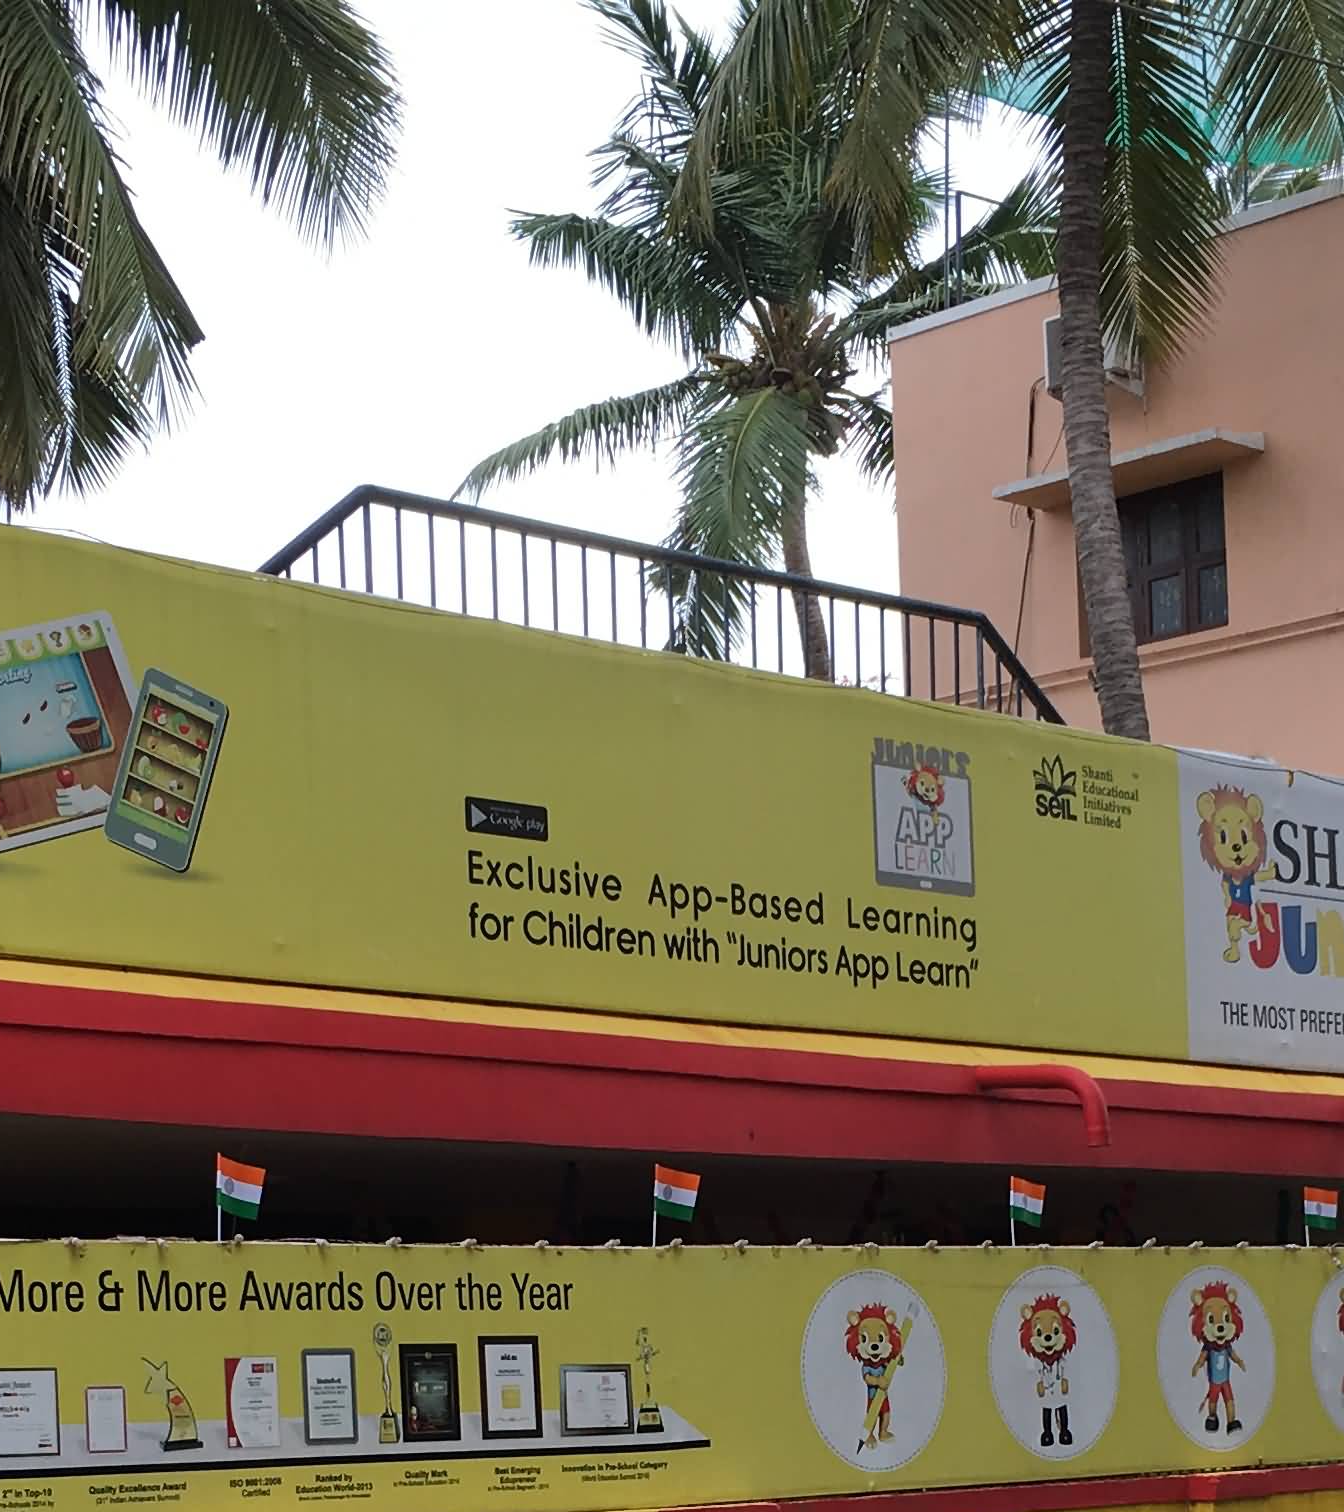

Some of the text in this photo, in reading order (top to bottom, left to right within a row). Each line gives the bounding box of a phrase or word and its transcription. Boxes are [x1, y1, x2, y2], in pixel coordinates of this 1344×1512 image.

[1081, 765, 1113, 782] Shanti
[1082, 782, 1139, 802] Educational
[1083, 796, 1132, 816] Initiatives
[896, 806, 953, 848] APP
[1084, 811, 1122, 829] Limited
[894, 841, 956, 877] LEARN
[466, 850, 978, 952] Exclusive App-Based Learning
[468, 902, 514, 942] for
[522, 909, 656, 959] Children
[663, 924, 720, 964] with
[834, 947, 891, 990] App
[1220, 1001, 1250, 1027] THE
[1253, 1003, 1296, 1032] MOST
[97, 1269, 124, 1313] &
[137, 1269, 228, 1312] More
[239, 1270, 365, 1312] Awards
[375, 1271, 446, 1312] Over
[455, 1272, 503, 1312] the
[509, 1272, 574, 1312] Year
[404, 1470, 448, 1480] Quality Mark
[494, 1466, 541, 1476] Best Emerging
[561, 1463, 596, 1473] Innovation
[605, 1461, 638, 1471] Pre-School
[639, 1461, 668, 1471] Category
[230, 1479, 243, 1488] ISO
[315, 1474, 343, 1483] Ranked
[88, 1482, 187, 1495] Quality Excellence Award
[241, 1488, 271, 1498] Certified
[295, 1485, 332, 1494] Education
